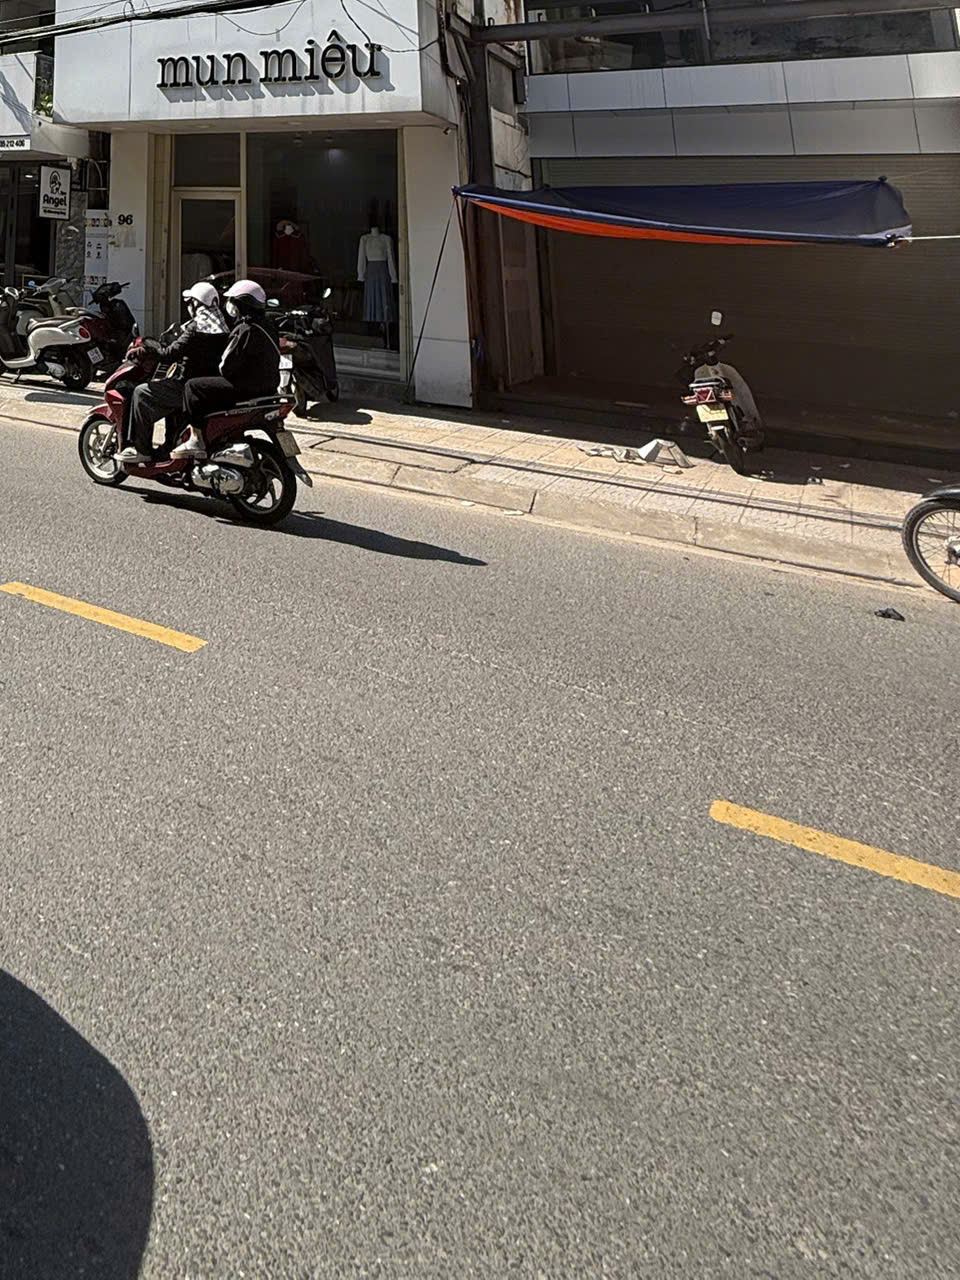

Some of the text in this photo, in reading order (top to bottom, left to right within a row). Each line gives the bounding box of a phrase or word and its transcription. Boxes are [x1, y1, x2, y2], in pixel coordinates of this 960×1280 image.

[156, 29, 382, 88] mun miêu
[43, 194, 67, 207] Angel
[117, 214, 134, 225] 96
